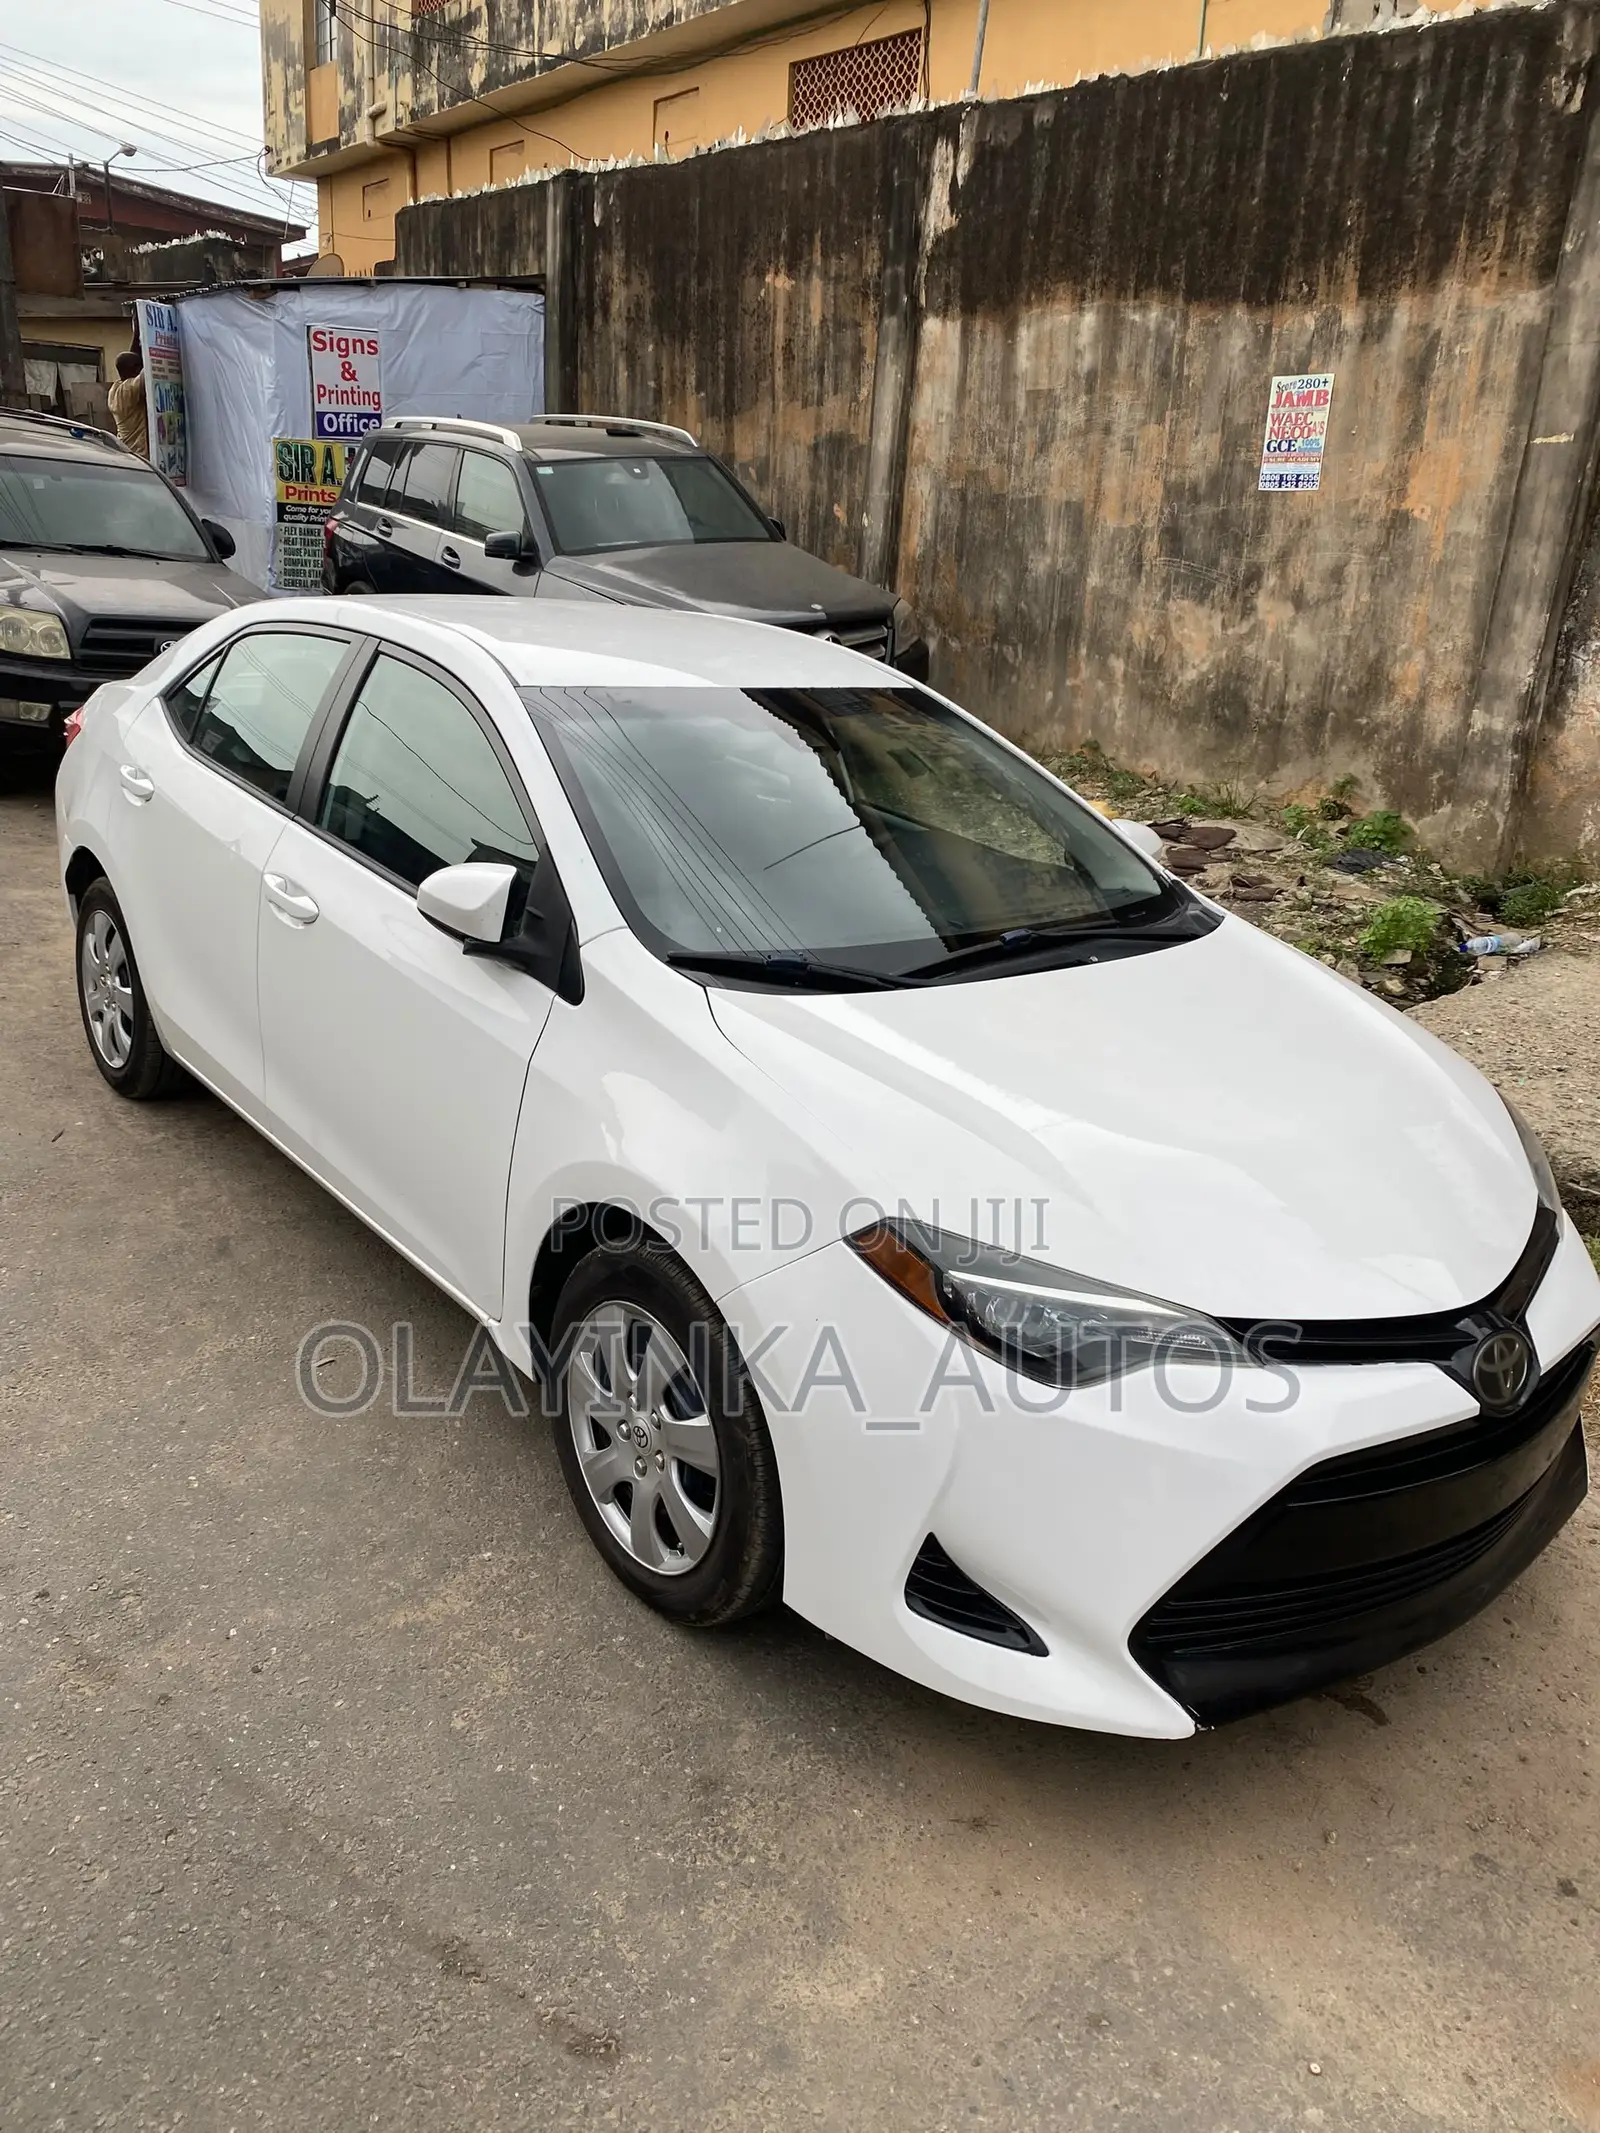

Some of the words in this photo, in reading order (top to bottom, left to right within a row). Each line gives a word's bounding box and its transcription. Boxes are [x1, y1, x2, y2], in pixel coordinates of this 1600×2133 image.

[312, 331, 379, 359] Signs
[341, 361, 359, 382] &
[1276, 381, 1298, 394] Score
[316, 384, 382, 411] Printing
[1271, 389, 1330, 408] JAMB
[323, 413, 380, 433] Office
[1270, 411, 1314, 427] WAEC
[1266, 439, 1298, 453] GCE
[276, 440, 317, 485] SIR
[285, 485, 337, 503] Prints
[286, 505, 307, 513] Come
[308, 506, 319, 514] for
[283, 514, 309, 523] quality
[284, 526, 298, 536] FLEX
[299, 527, 322, 537] BANNER
[283, 537, 298, 546] HEAT
[283, 547, 303, 557] HOUSE
[283, 558, 312, 568] COMPANY
[283, 568, 307, 578] RUBBER
[283, 579, 309, 588] GENERAL
